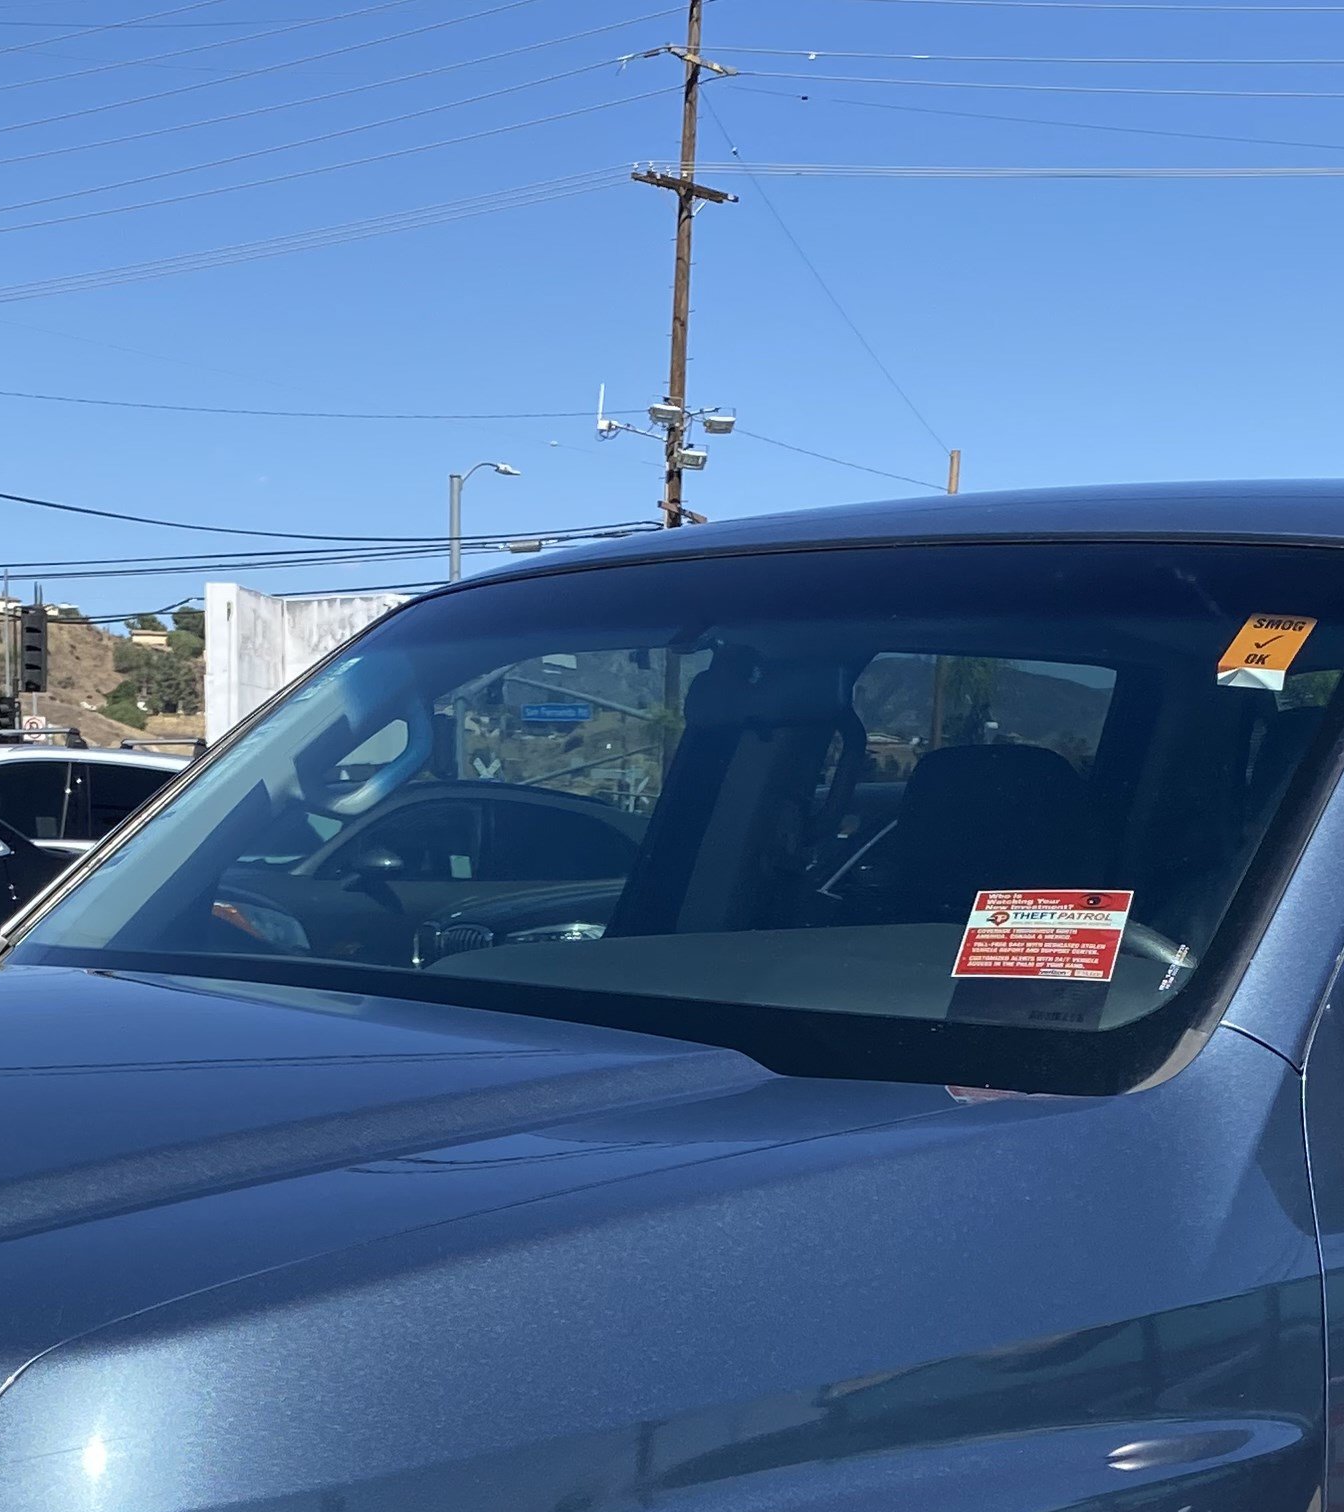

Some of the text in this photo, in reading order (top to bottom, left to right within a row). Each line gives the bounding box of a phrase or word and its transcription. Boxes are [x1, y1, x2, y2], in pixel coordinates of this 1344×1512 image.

[1253, 618, 1307, 632] SMOG
[1244, 653, 1272, 666] OK
[986, 898, 1034, 906] Watching
